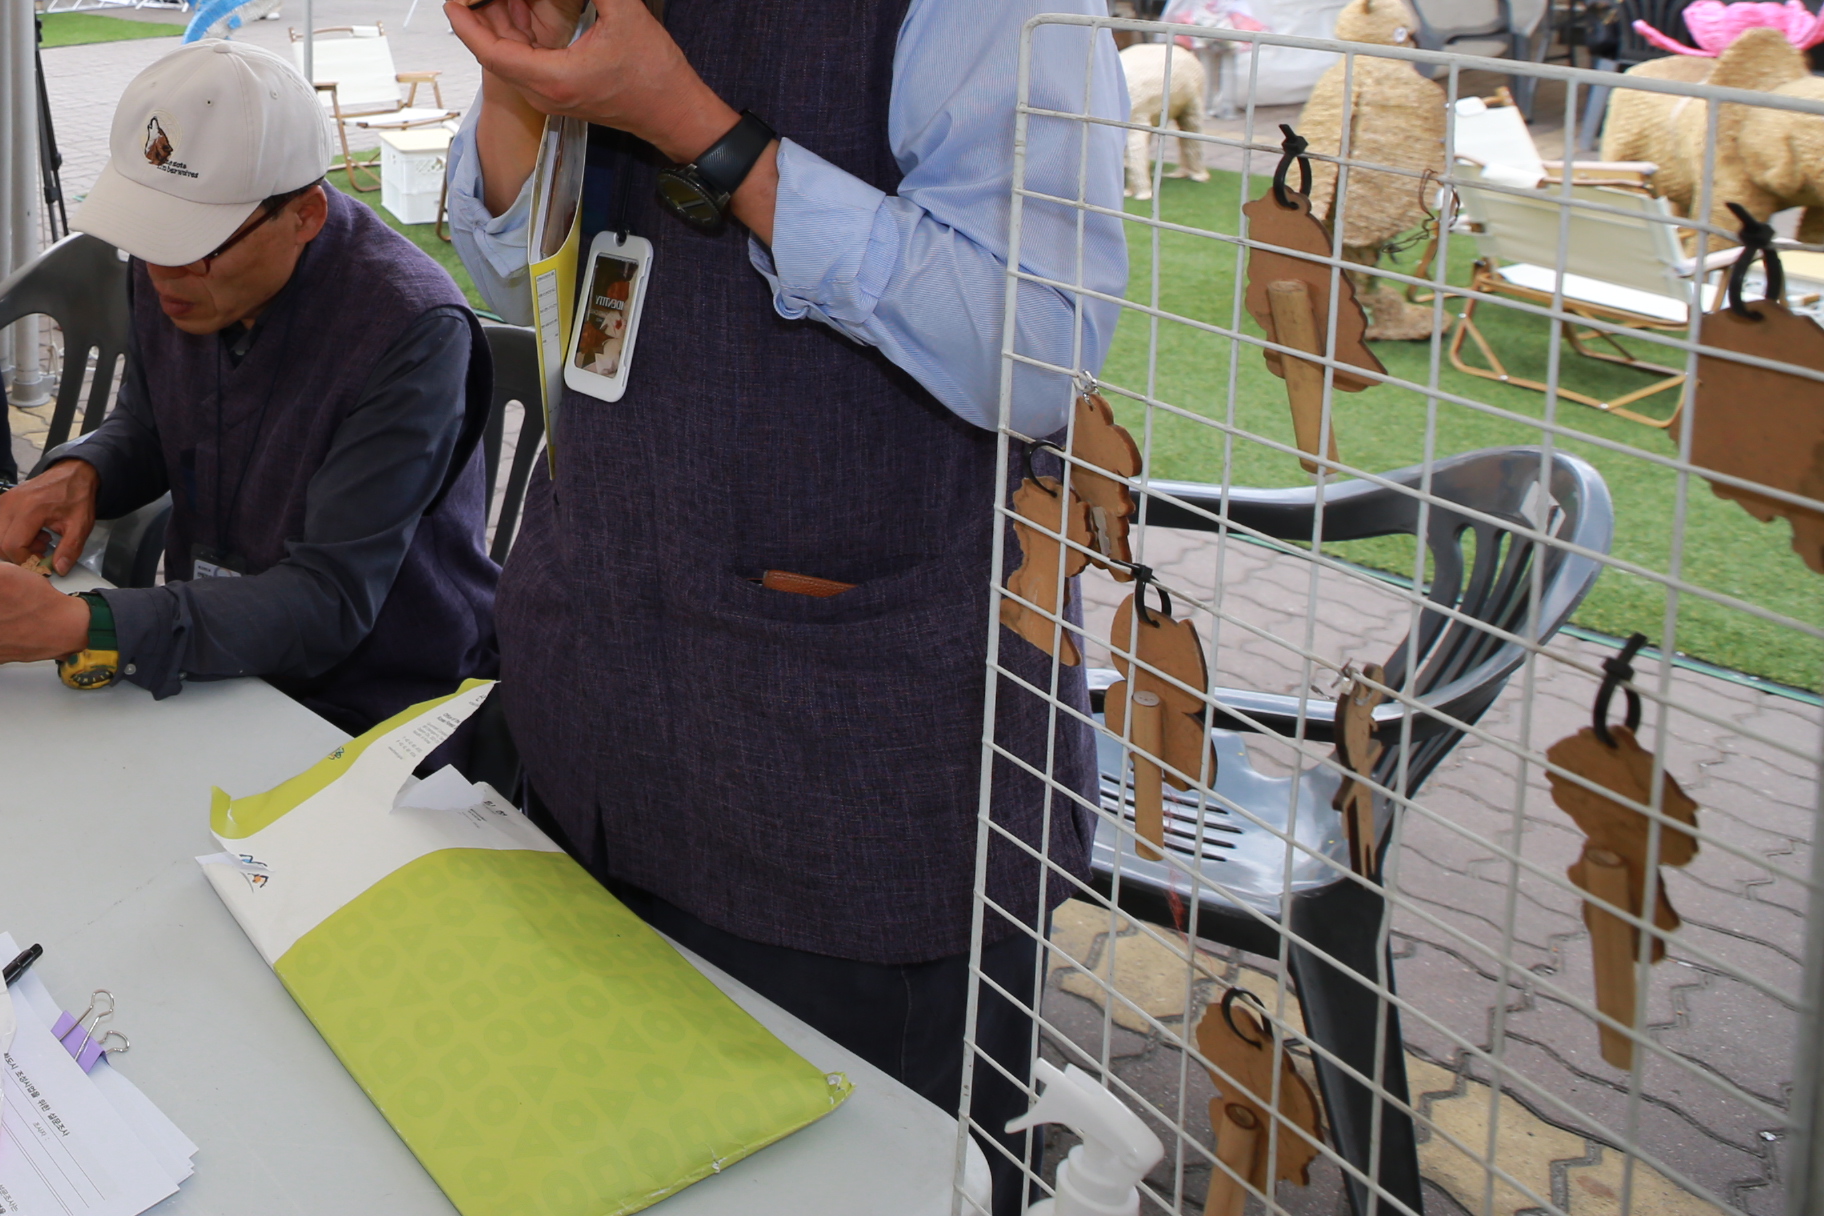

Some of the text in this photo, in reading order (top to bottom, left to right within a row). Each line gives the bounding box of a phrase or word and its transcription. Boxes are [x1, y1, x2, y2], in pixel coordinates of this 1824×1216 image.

[14, 1069, 40, 1098] 조성사업을
[37, 1098, 50, 1112] 위한
[47, 1112, 70, 1137] 설문조사
